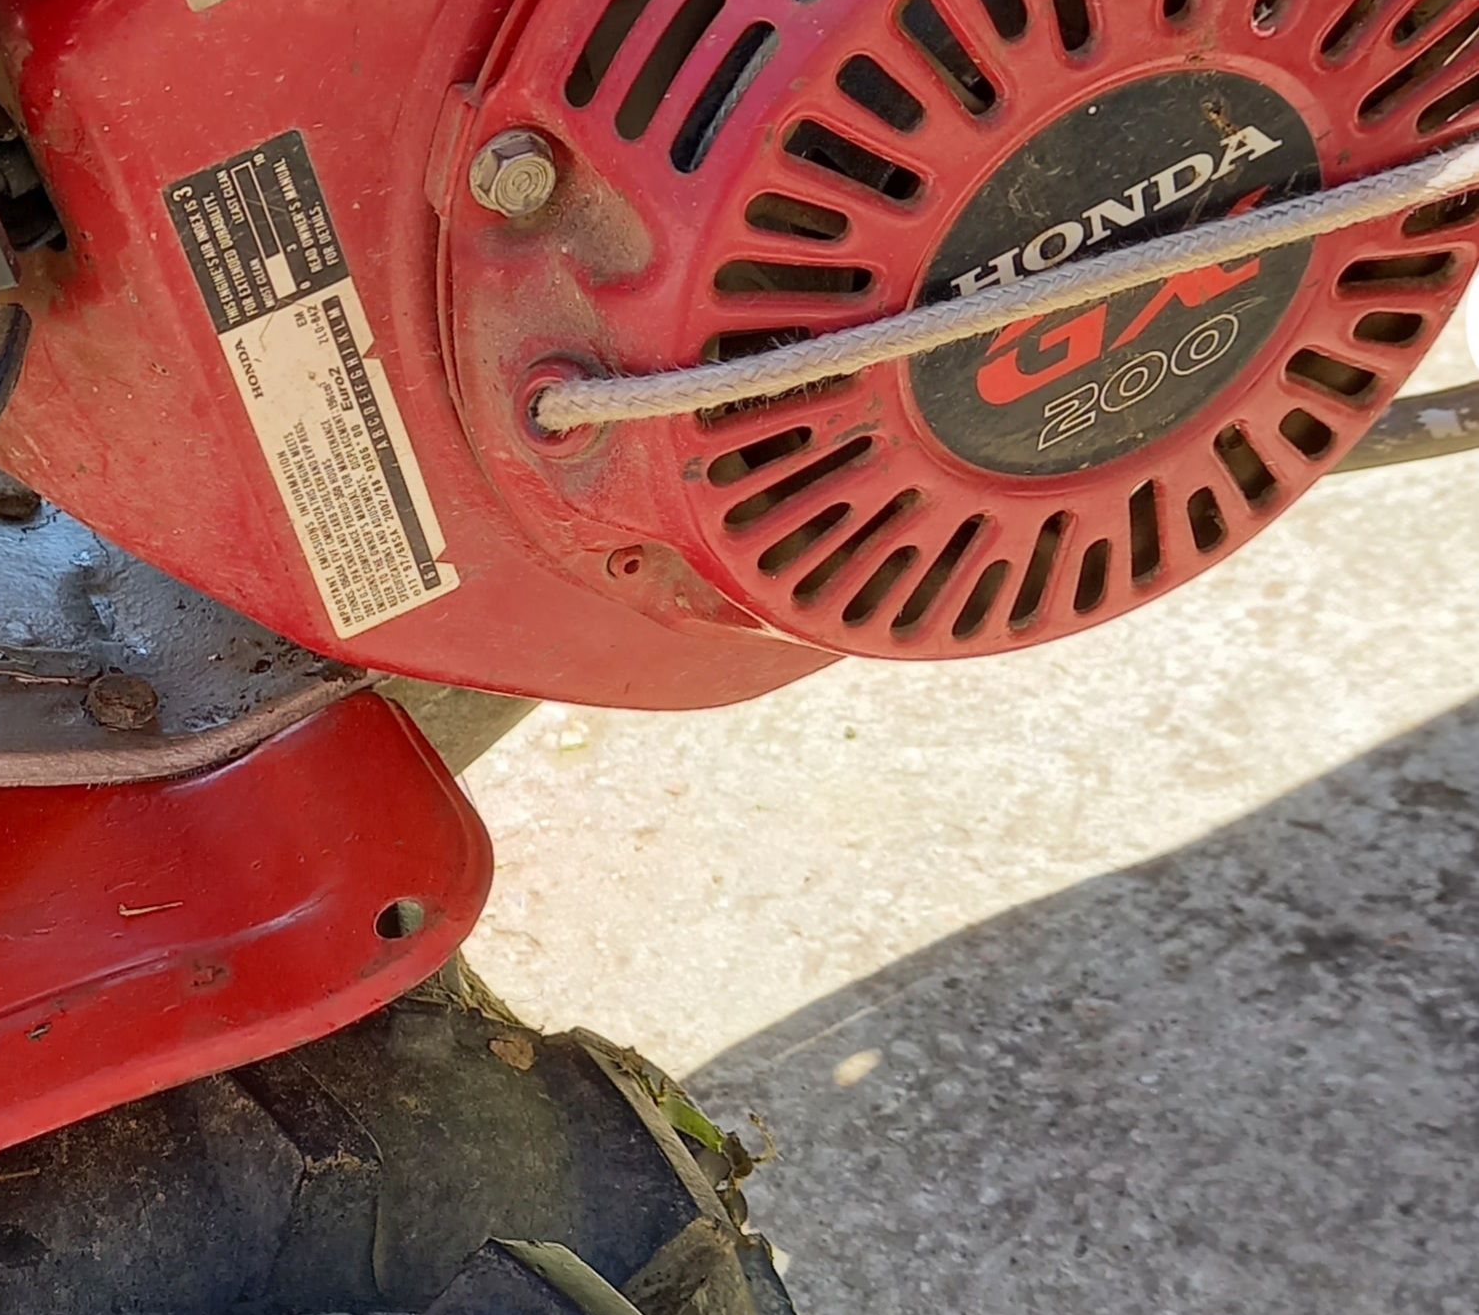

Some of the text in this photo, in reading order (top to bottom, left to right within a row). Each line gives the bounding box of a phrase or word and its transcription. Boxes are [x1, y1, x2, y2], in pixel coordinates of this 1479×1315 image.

[251, 152, 266, 166] 10
[215, 169, 244, 224] LEAST CLEAN
[270, 157, 324, 273] READ OWNER'S MANUAL
[949, 125, 1282, 296] HONDA
[170, 184, 241, 324] THIS ENGINE'S AIR INDEX IS 3
[200, 191, 258, 316] FOR EXTENDED DURABILITY.
[285, 242, 298, 252] 3
[305, 200, 339, 265] FOR DETAILS.
[248, 257, 275, 308] MOST CLEAN
[298, 280, 311, 290] 0
[292, 310, 307, 328] EM
[232, 337, 263, 399] HONDA
[326, 364, 354, 412] Euro2
[1037, 313, 1239, 451] 200
[282, 431, 300, 458] MEETS
[307, 459, 321, 476] AND
[293, 458, 313, 488] ENGINE
[320, 457, 339, 485] HOURS
[304, 488, 319, 506] THIS
[319, 418, 398, 607] REFER TO THE OWNER'S MANUAL FOR MAINTENANCE
[276, 449, 353, 628] IMPORTANT EMISSIONS INFORMATION
[335, 532, 349, 549] AND
[347, 528, 373, 575] COMPLIANCE
[374, 529, 388, 546] AND
[349, 568, 363, 584] EPA
[364, 573, 387, 613] EMISSIONS
[381, 545, 410, 602] SPECIFICATIONS
